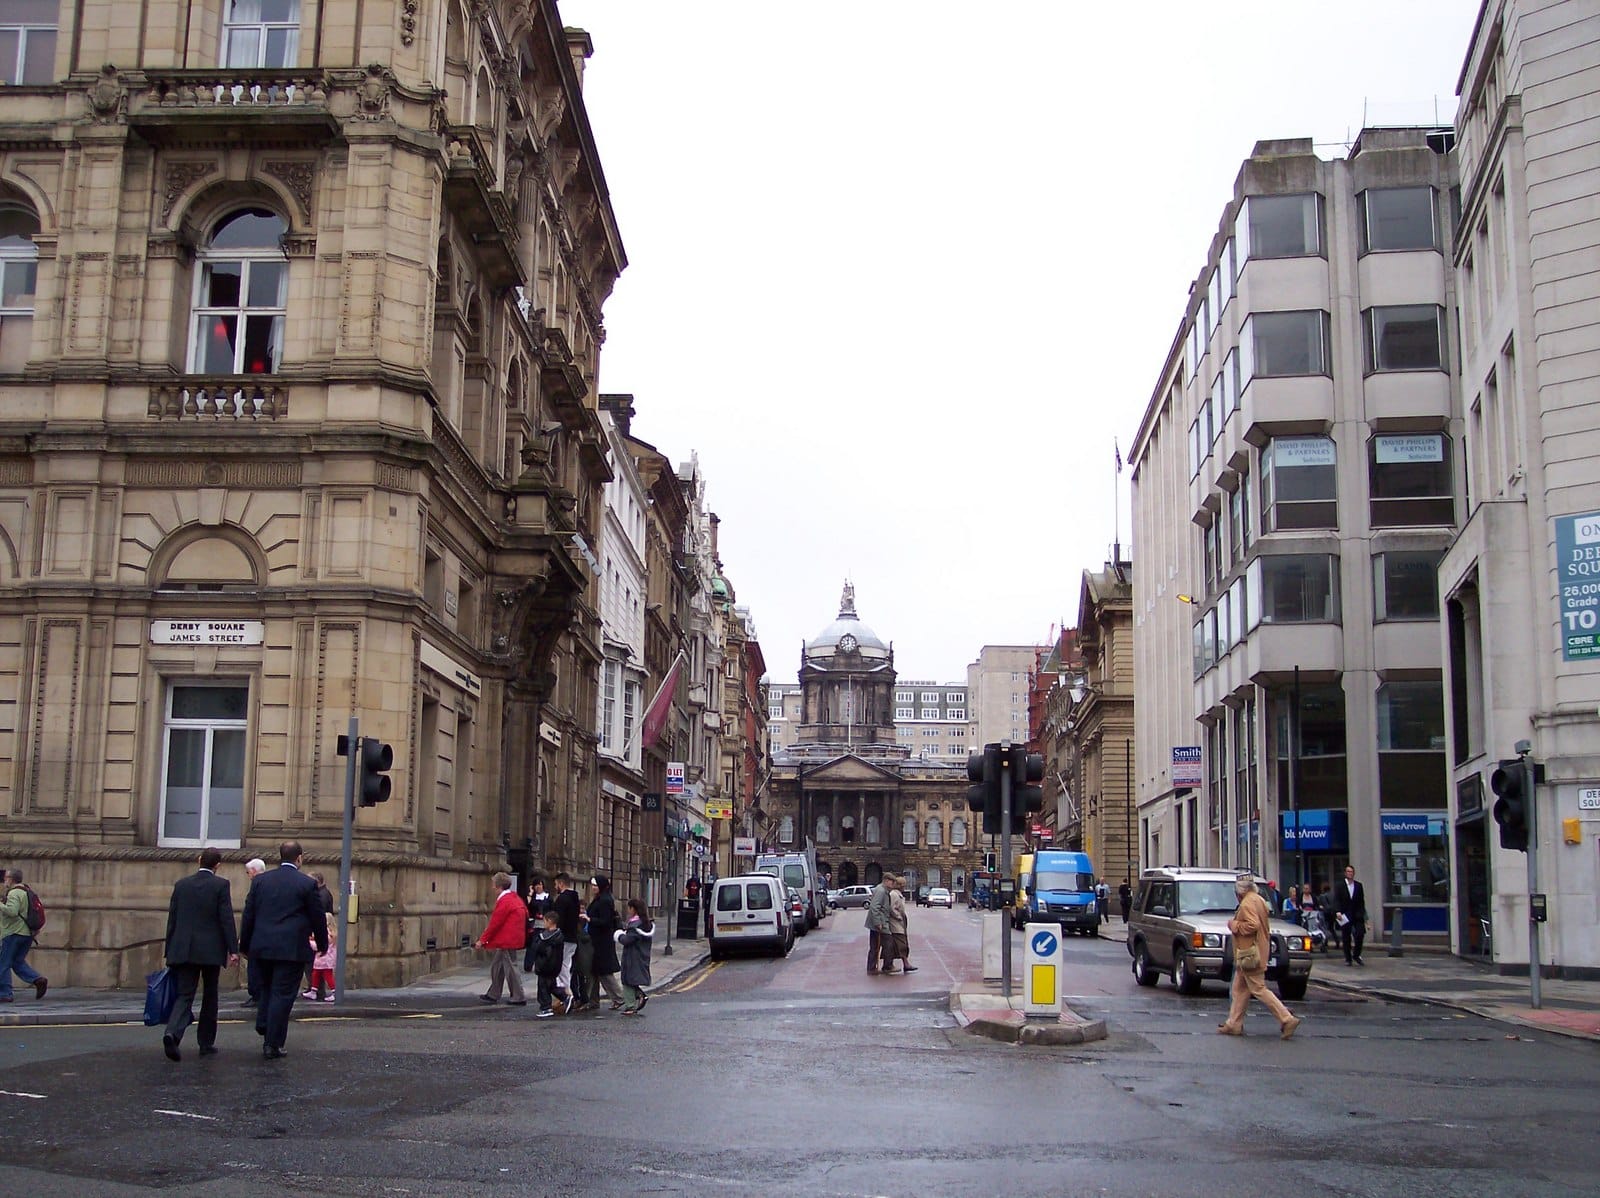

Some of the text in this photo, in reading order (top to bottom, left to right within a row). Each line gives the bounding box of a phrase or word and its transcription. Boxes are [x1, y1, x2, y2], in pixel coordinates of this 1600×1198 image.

[1567, 596, 1598, 608] Grade
[1563, 609, 1597, 631] TO
[170, 634, 244, 642] JAMES STREET
[1568, 636, 1594, 645] CBRE
[1174, 748, 1201, 757] Smith
[673, 768, 682, 776] LET
[1383, 822, 1426, 830] blueArrow
